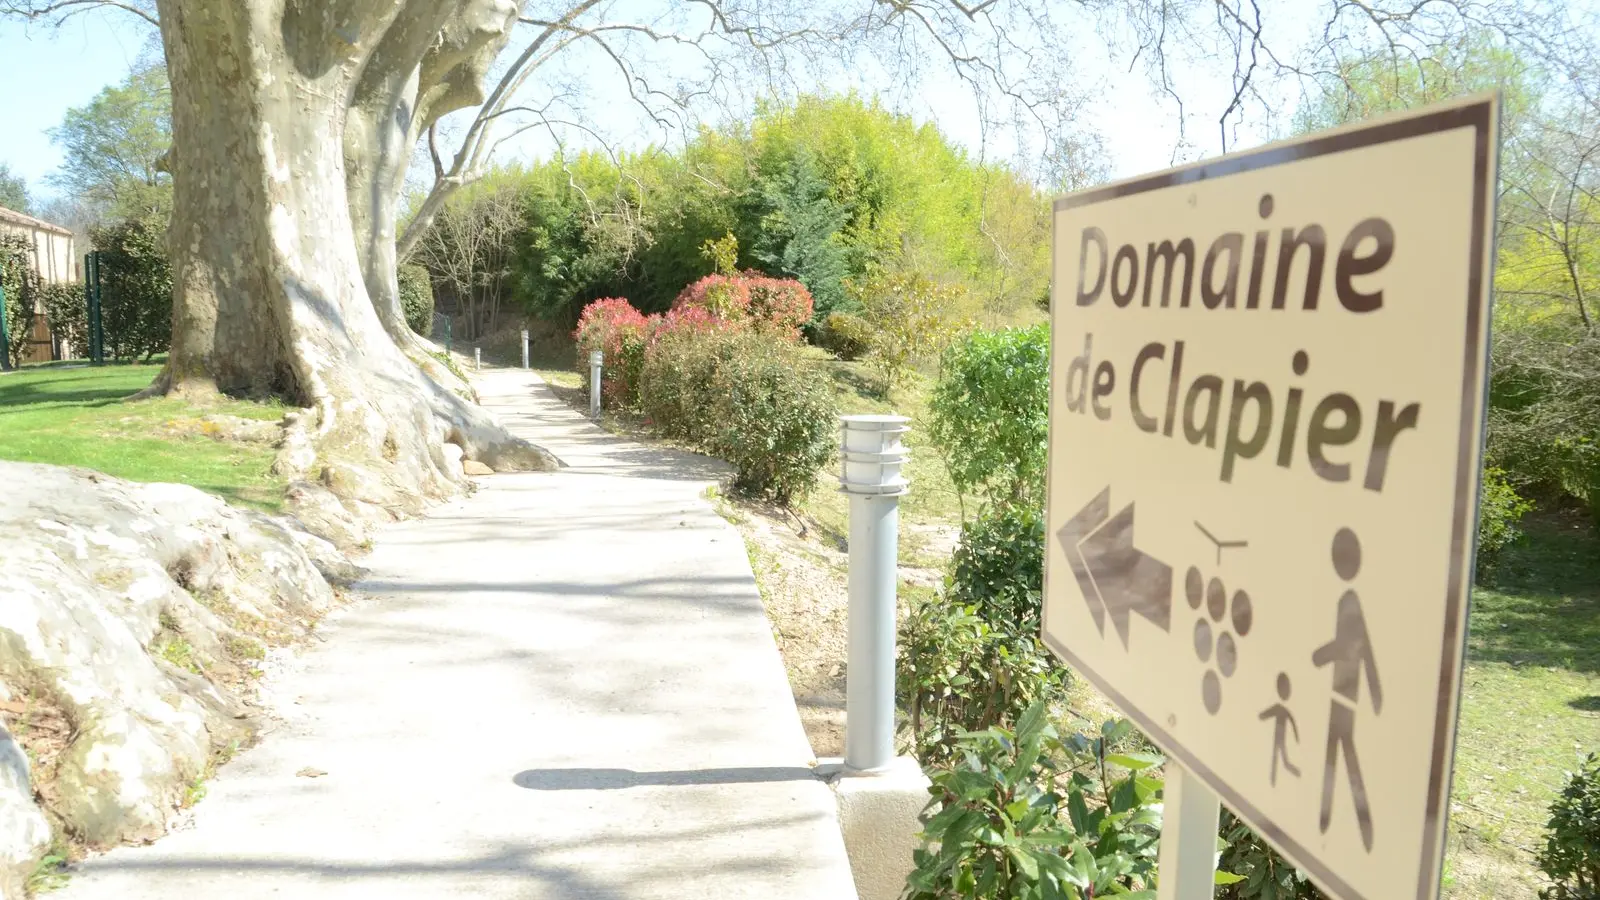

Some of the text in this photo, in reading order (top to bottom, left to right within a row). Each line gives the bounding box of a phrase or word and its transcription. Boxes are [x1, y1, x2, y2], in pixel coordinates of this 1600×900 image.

[1075, 193, 1396, 314] Domaine
[1066, 333, 1421, 493] de Clapier
